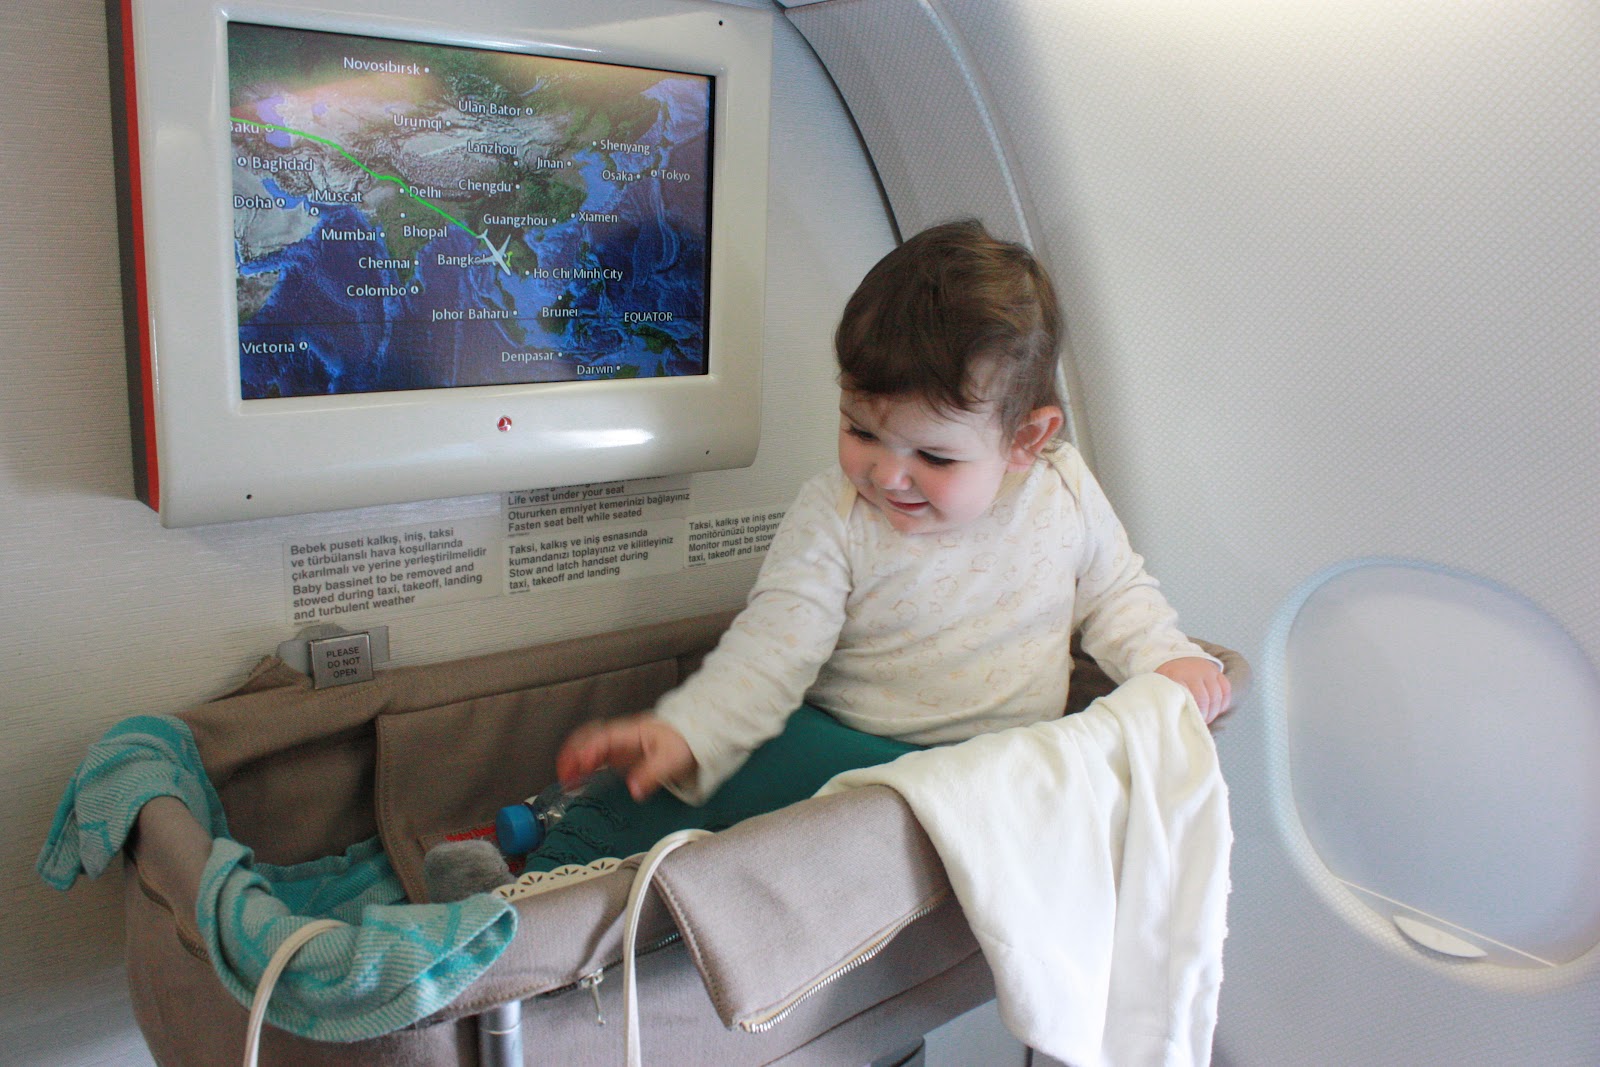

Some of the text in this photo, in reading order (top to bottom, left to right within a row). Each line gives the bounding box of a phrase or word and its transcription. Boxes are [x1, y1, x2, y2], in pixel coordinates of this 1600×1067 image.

[343, 57, 421, 75] Novosibirsk
[458, 100, 521, 116] Ulan Bator
[393, 114, 442, 130] Urumqi
[467, 141, 517, 155] Lanzhou
[600, 139, 651, 155] Shenyang
[252, 156, 314, 173] Baghdad
[536, 157, 564, 170] Jinan
[602, 169, 634, 182] Osaka
[661, 169, 691, 184] Tokyo
[409, 186, 442, 198] Delhi
[458, 178, 512, 194] Chengdu
[233, 195, 272, 209] Doha
[315, 189, 363, 203] Muscat
[483, 213, 548, 229] Guangzhou
[578, 211, 618, 223] Xiamen
[321, 228, 377, 242] Mumbai
[403, 225, 448, 240] Bhopal
[358, 256, 410, 270] Chennai
[533, 268, 623, 281] Ho Chi Minh City
[346, 284, 407, 298] Colombo
[431, 307, 509, 322] Johor Baharu
[542, 306, 578, 318] Brunei
[624, 310, 673, 323] EQUATOR
[242, 340, 295, 355] Victoria
[501, 350, 554, 364] Denpasar
[577, 364, 613, 375] Darwin
[508, 495, 526, 505] Life
[529, 493, 549, 503] vest
[552, 491, 579, 500] under
[582, 487, 603, 499] your
[605, 485, 624, 495] seat
[508, 494, 689, 520] Otururken emniyet kemerinizi bağlayınız
[508, 508, 642, 532] Fasten seat belt while seated
[689, 521, 713, 530] Taksi,
[716, 518, 739, 527] kalkış
[752, 514, 765, 522] iniş
[689, 523, 779, 541] monitörünüzü toplayın
[291, 527, 454, 555] Bebek puseti kalkış, iniş, taksi
[509, 543, 537, 554] Taksi,
[541, 540, 567, 550] kalkış
[584, 535, 600, 545] iniş
[603, 529, 648, 542] esnasında
[689, 542, 720, 552] Monitor
[722, 538, 742, 546] must
[756, 534, 776, 542] stow
[291, 539, 463, 567] ve türbülanslı hava koşullarında
[509, 552, 569, 566] kumandanızı
[572, 546, 616, 558] toplayınız
[631, 536, 673, 549] kilitleyiniz
[689, 554, 705, 562] taxi,
[708, 548, 735, 559] takeoff
[737, 546, 751, 555] and
[292, 565, 349, 582] çıkarılmalı
[368, 559, 401, 573] yerine
[405, 547, 487, 568] yerleştirilmelidir
[509, 552, 648, 577] Stow and latch handset during
[293, 562, 474, 595] Baby bassinet to be removed and
[509, 567, 620, 589] taxi, takeoff and landing
[293, 574, 482, 607] stowed during taxi, takeoff, landing
[294, 596, 415, 620] and turbulent weather
[327, 647, 359, 658] PLEASE
[328, 657, 360, 669] DO NOT
[334, 668, 357, 678] OPEN
